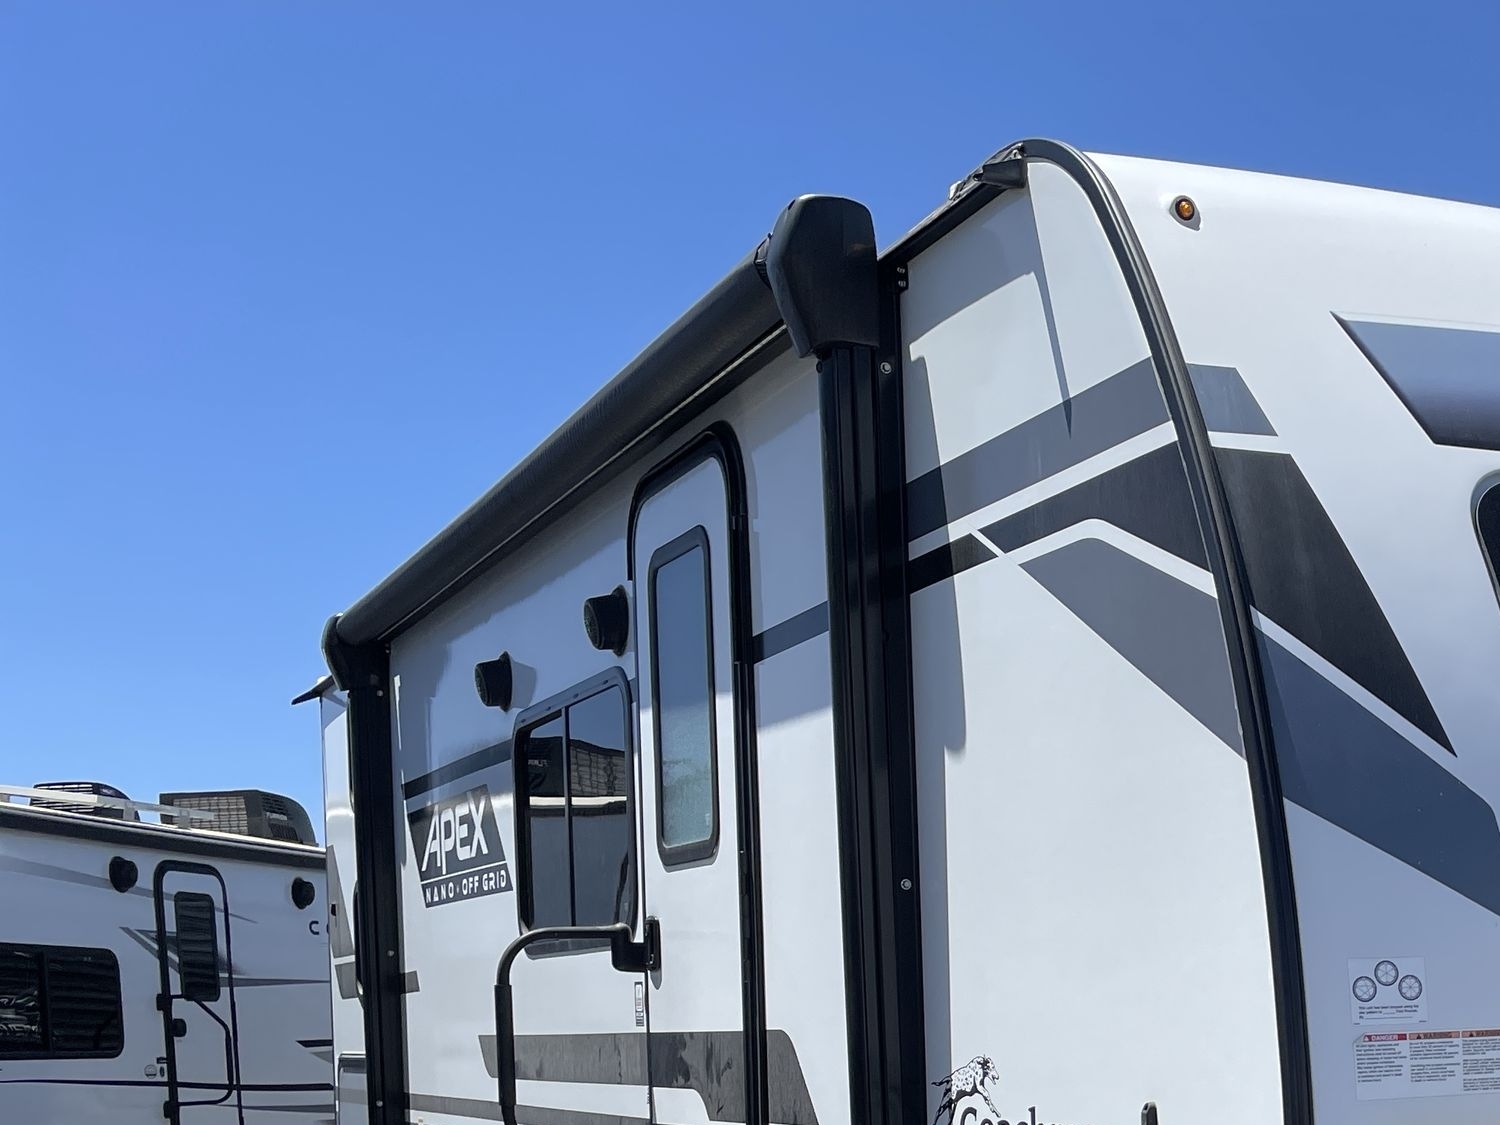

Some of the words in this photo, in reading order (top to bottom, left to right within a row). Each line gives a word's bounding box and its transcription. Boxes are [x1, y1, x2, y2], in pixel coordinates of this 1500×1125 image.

[421, 791, 489, 875] APEX
[425, 883, 455, 903] NANO
[462, 877, 479, 896] OFF
[482, 870, 507, 891] GRID
